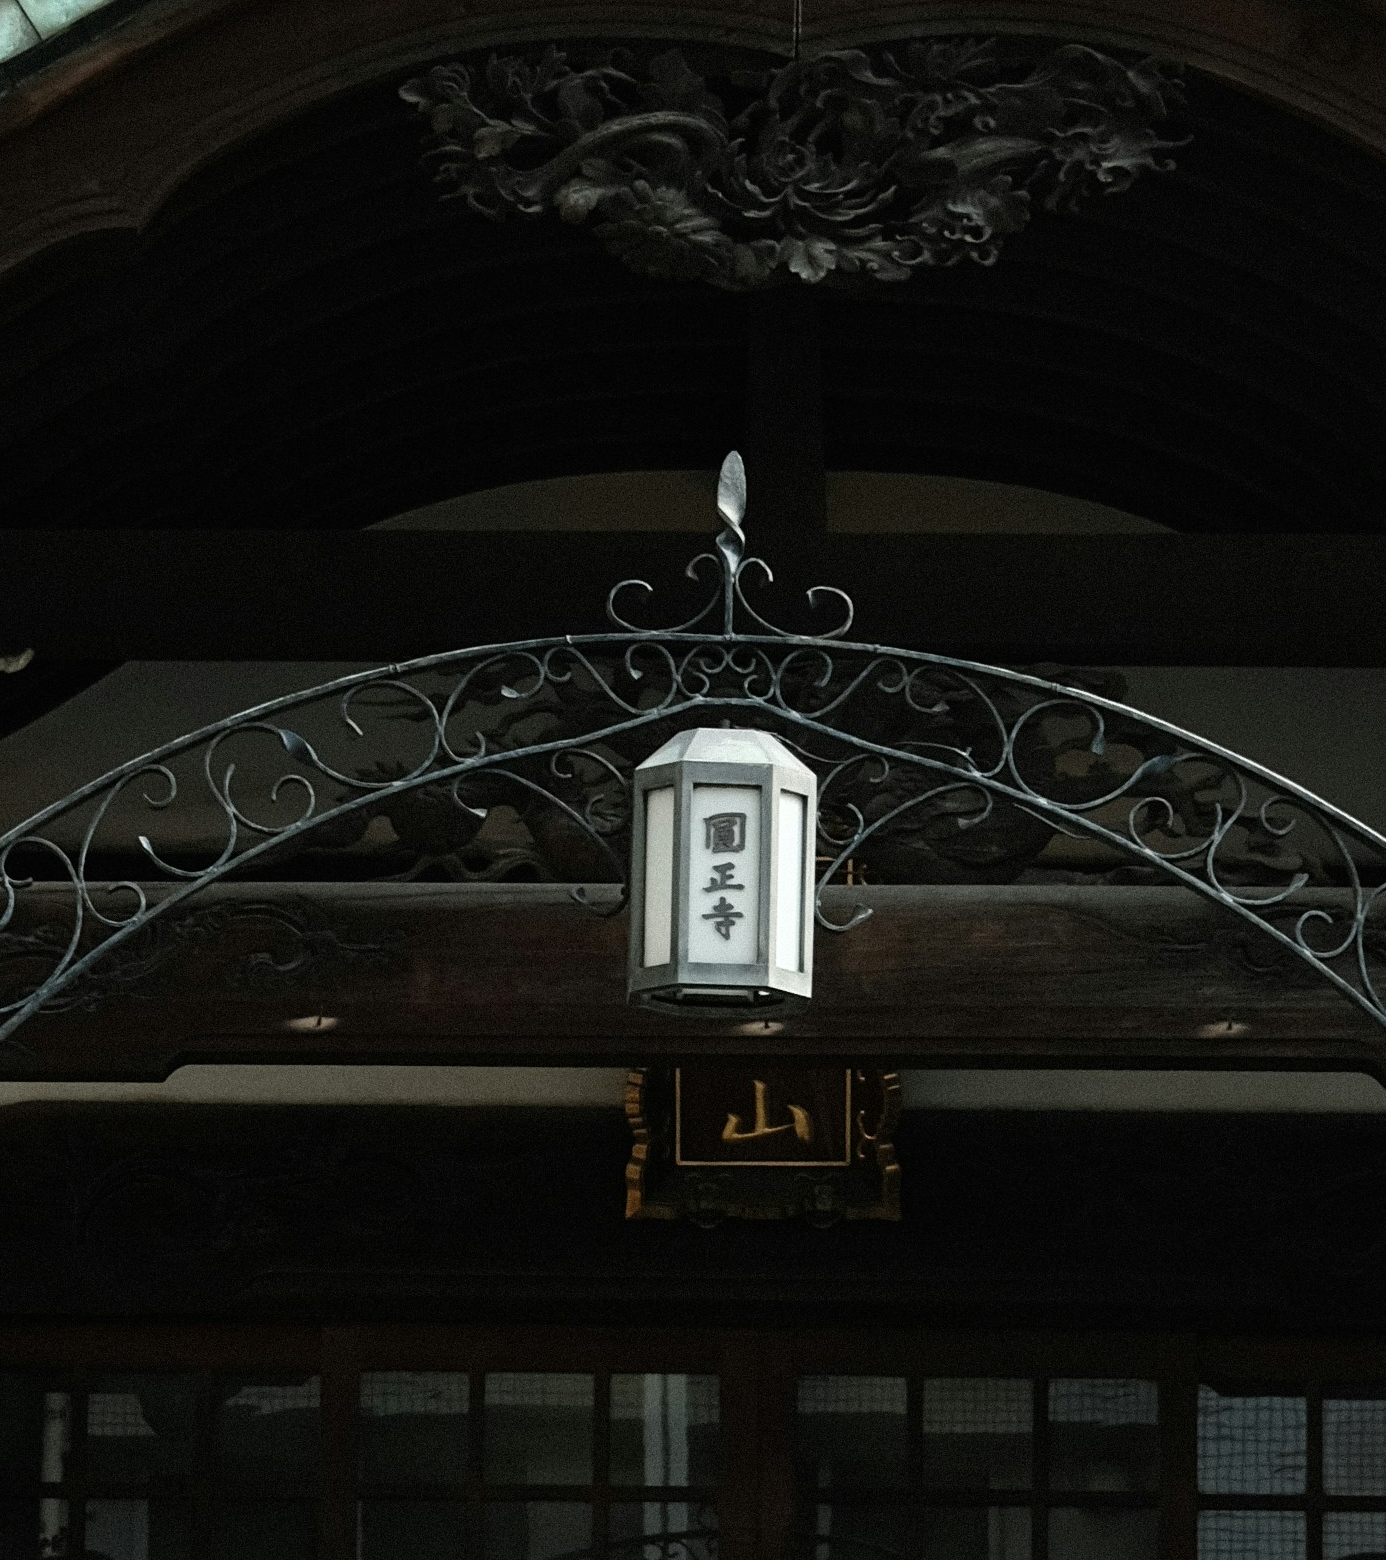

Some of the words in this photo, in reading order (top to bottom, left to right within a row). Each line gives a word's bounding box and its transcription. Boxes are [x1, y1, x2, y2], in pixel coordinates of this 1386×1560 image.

[702, 812, 747, 940] 圓正寺
[721, 1080, 812, 1142] 山
